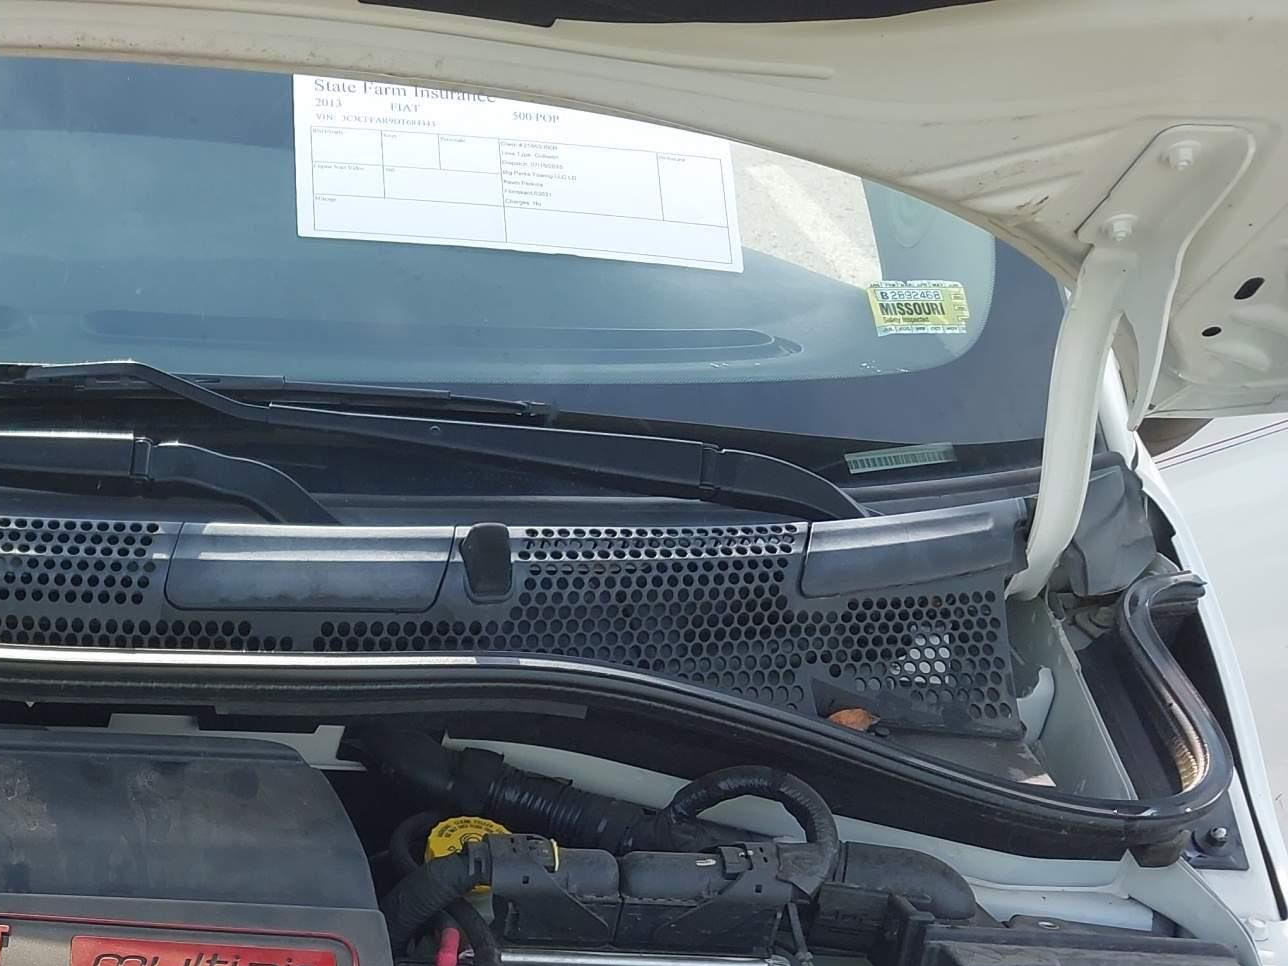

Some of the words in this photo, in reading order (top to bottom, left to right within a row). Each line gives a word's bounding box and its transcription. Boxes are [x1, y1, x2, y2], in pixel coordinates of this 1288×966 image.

[314, 79, 357, 94] State
[363, 81, 407, 97] Farm
[315, 97, 343, 108] 2013
[390, 103, 421, 113] FIAT
[879, 302, 945, 316] MISSOURI
